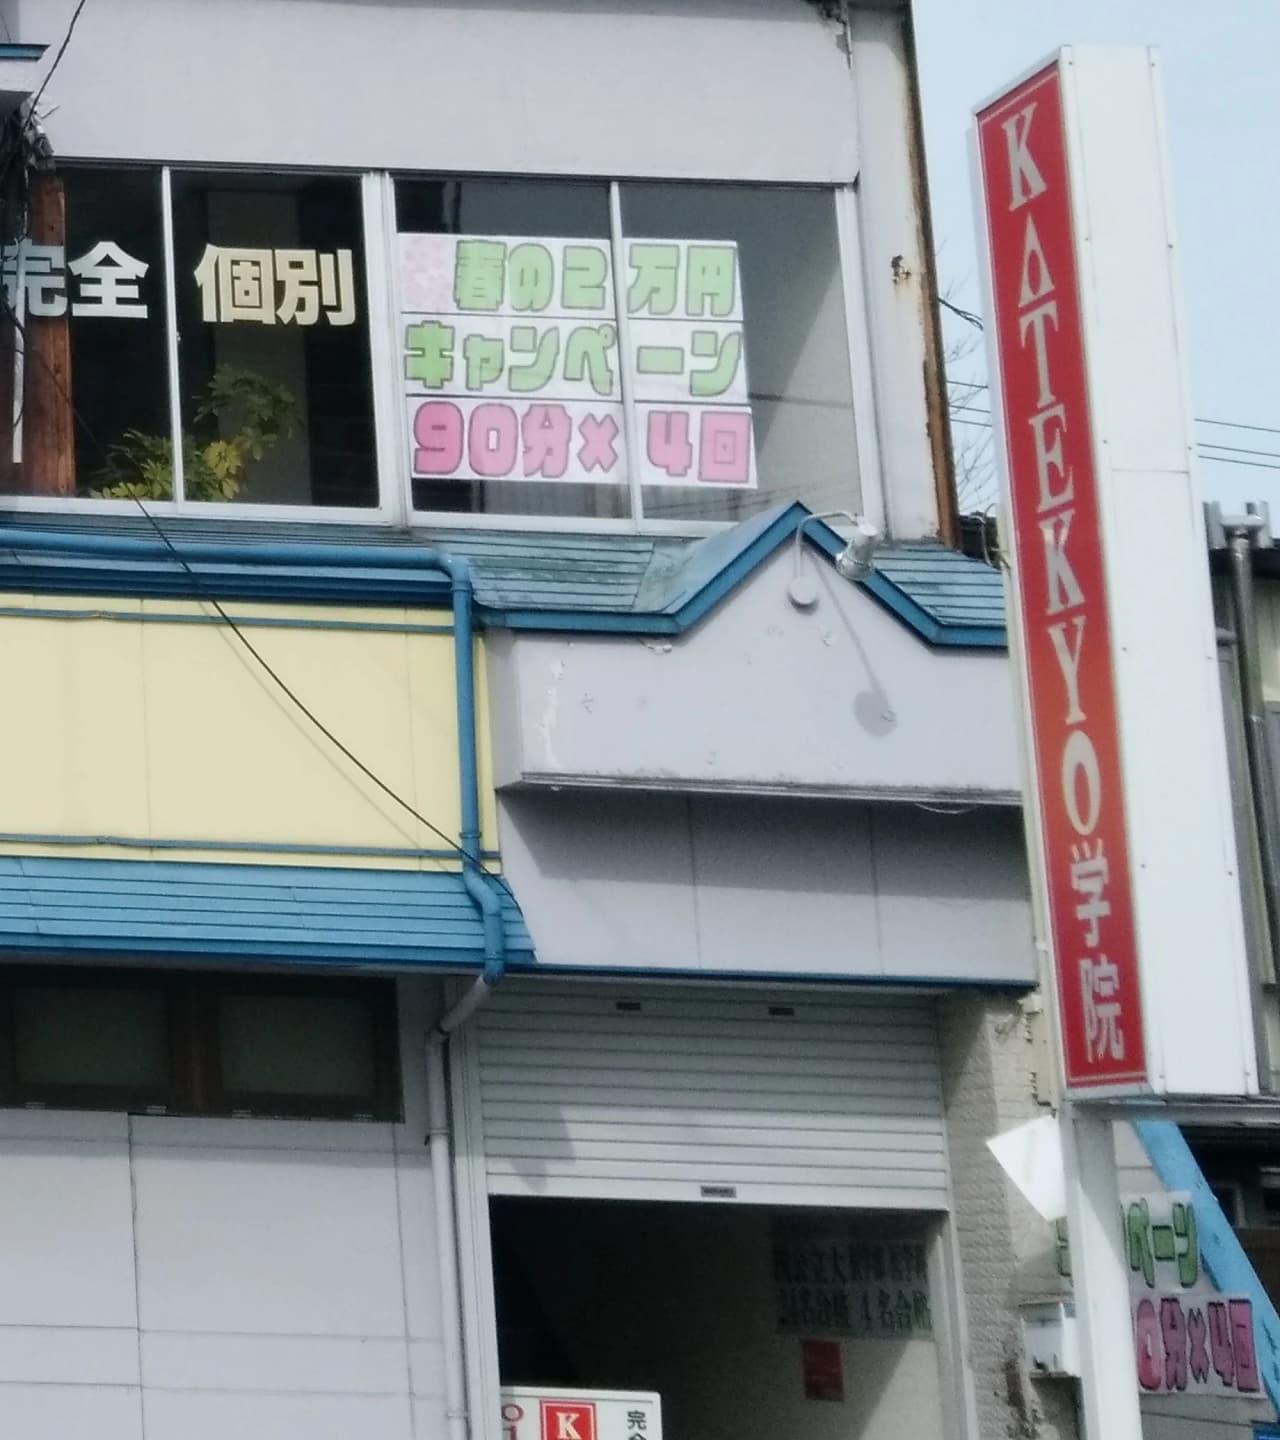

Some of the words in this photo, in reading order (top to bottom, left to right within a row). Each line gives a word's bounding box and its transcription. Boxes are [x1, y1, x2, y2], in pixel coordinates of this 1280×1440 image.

[402, 320, 743, 398] キャンペーン
[1003, 105, 1127, 1063] KATEKYO学院
